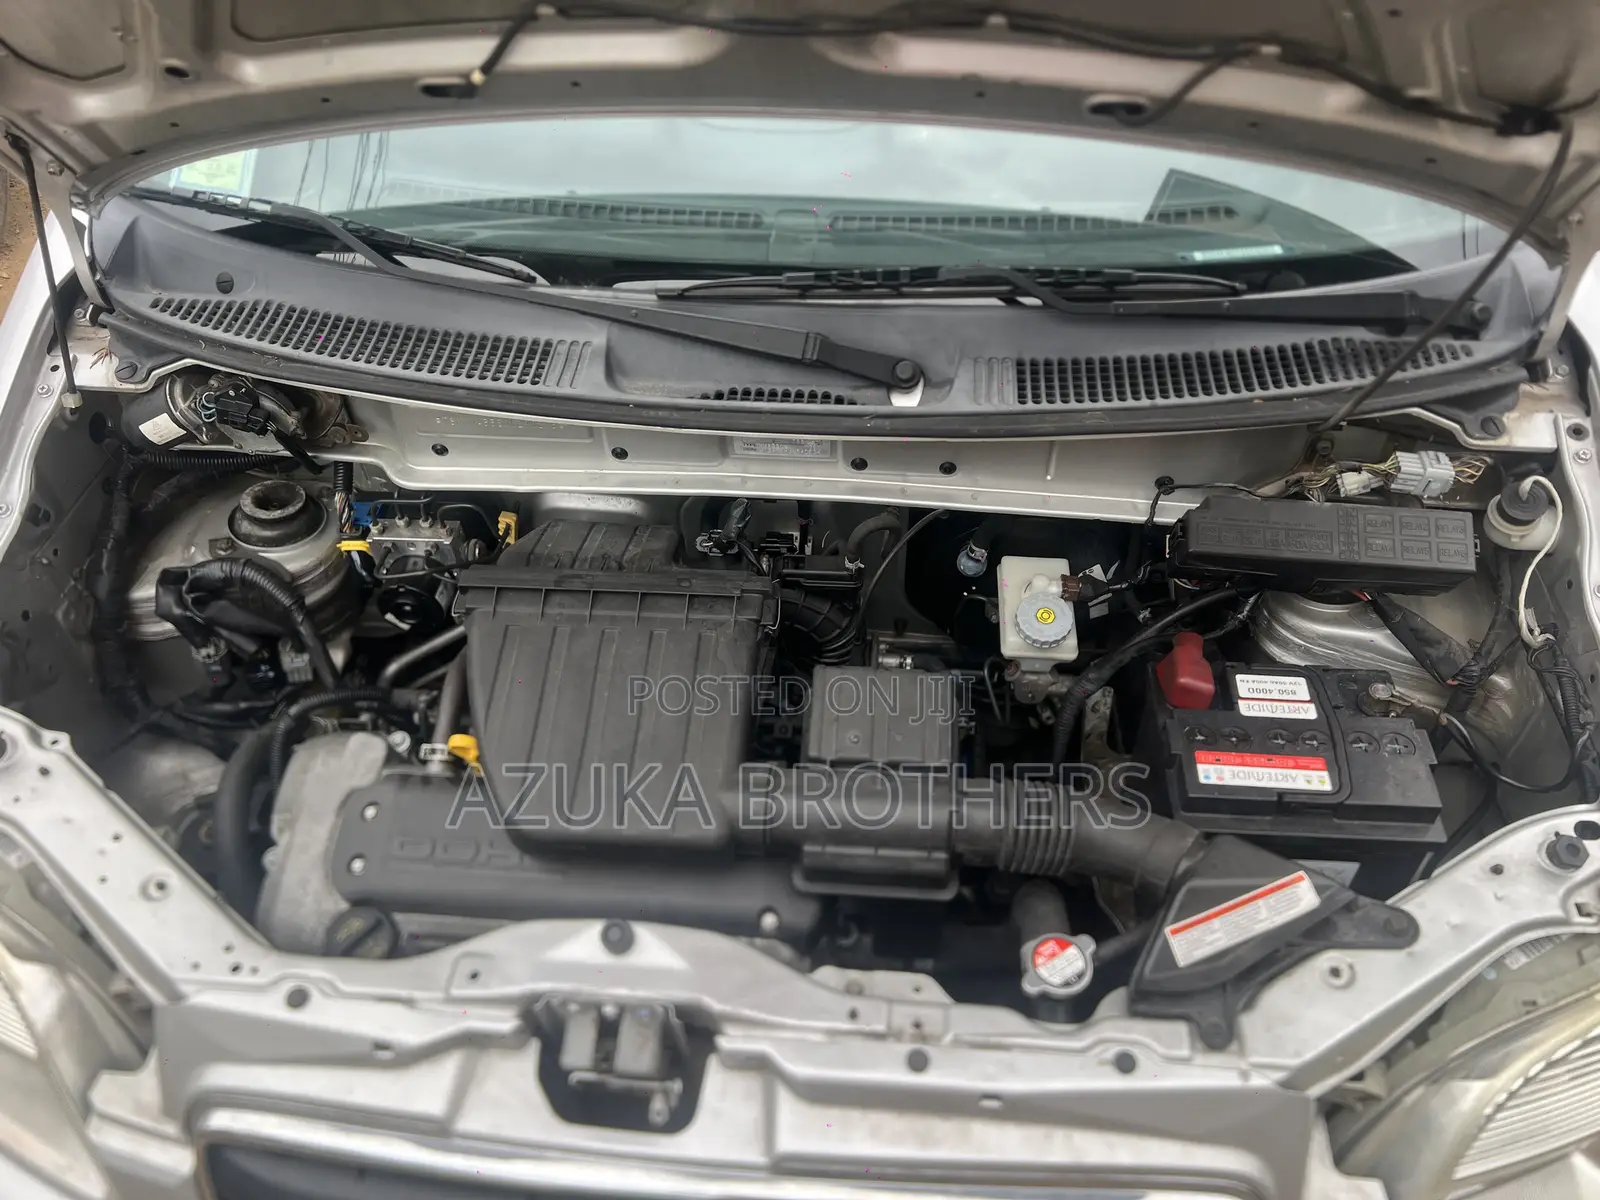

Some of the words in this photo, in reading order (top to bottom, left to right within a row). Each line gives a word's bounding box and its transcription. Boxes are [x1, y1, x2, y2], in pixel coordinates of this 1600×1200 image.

[1244, 703, 1310, 715] ARTEMIDE
[1228, 769, 1299, 783] ARTEMIDE
[394, 837, 524, 867] DOH
